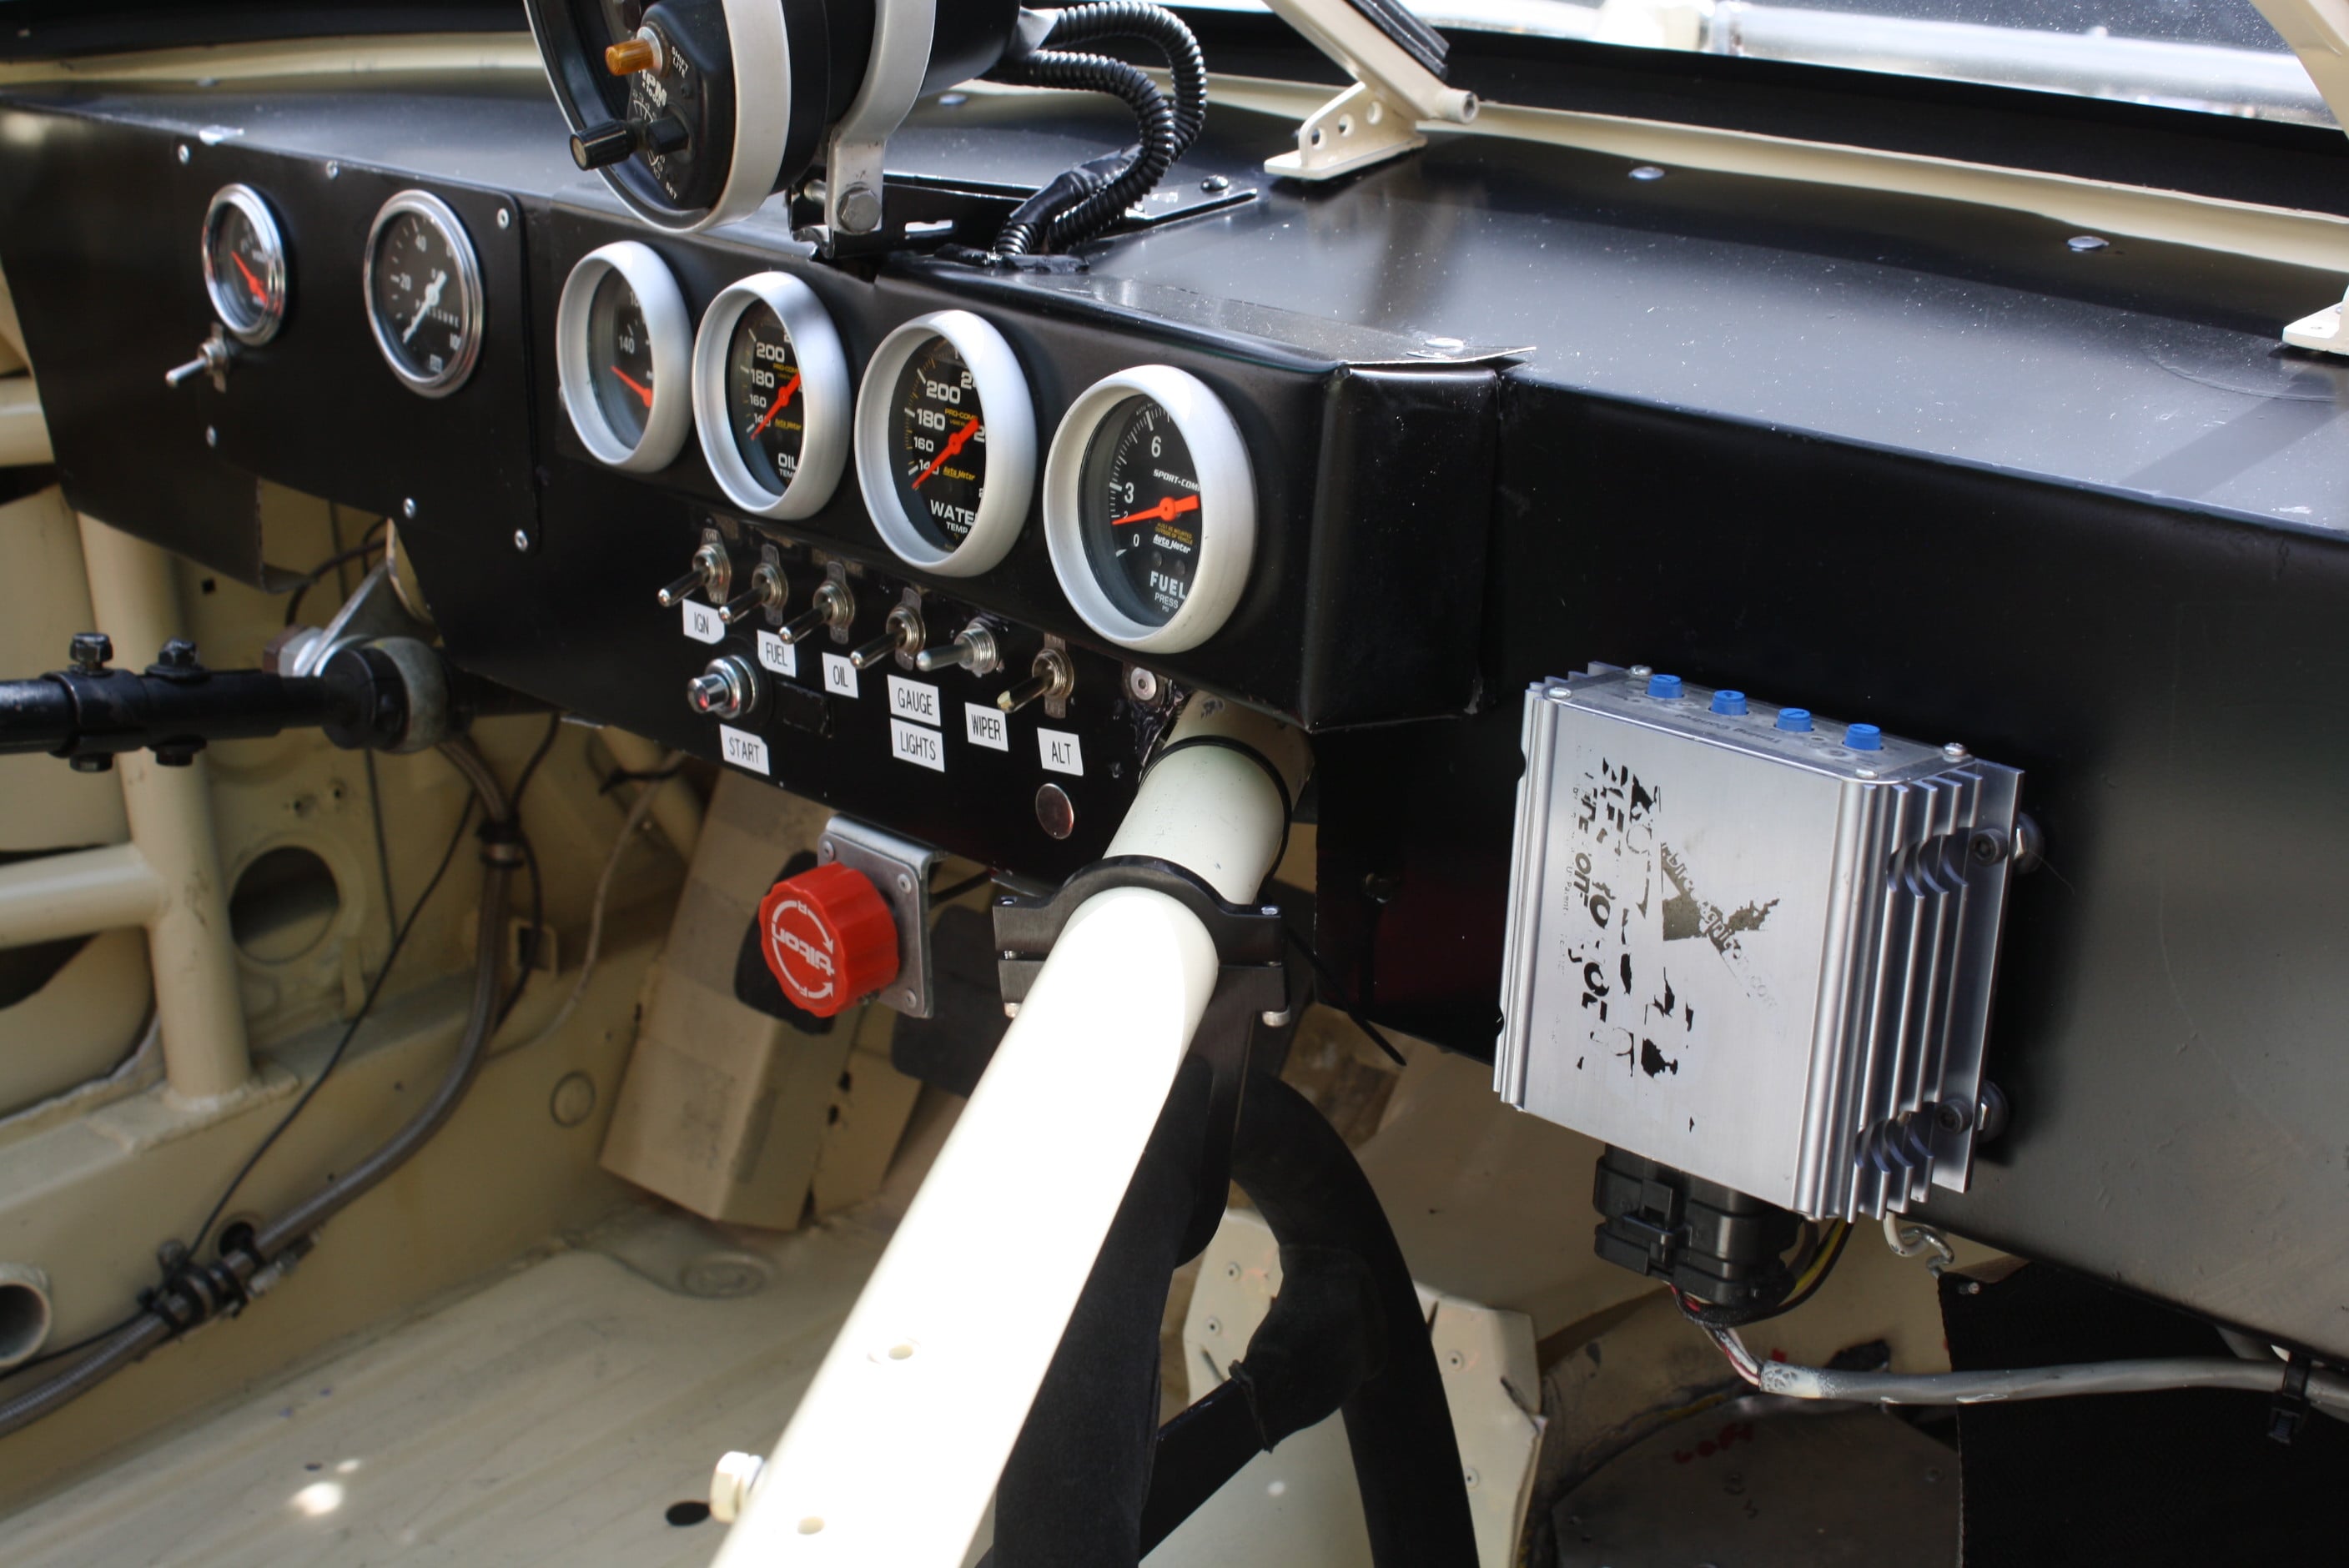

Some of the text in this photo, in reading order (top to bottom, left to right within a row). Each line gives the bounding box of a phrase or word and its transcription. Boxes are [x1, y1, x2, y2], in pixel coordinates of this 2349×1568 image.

[671, 46, 689, 70] SHIFT
[672, 58, 686, 78] LITE
[666, 182, 677, 199] SET
[400, 272, 412, 291] 20
[415, 299, 460, 329] PESSURE
[618, 335, 636, 354] 140
[757, 342, 785, 363] 200
[751, 368, 774, 389] 180
[750, 394, 767, 408] 160
[926, 380, 961, 405] 200
[917, 408, 946, 431] 180
[913, 436, 934, 453] 160
[1151, 435, 1162, 458] 6
[777, 453, 797, 470] OIL
[779, 468, 793, 479] TEM
[943, 466, 976, 481] Auto Meter
[1124, 482, 1134, 504] 3
[930, 499, 977, 526] WATE
[946, 521, 968, 535] TEMP
[1133, 533, 1140, 547] 0
[1153, 534, 1191, 554] Auto Meter
[1149, 570, 1186, 600] FUEL
[1154, 591, 1179, 609] PRESS
[693, 610, 710, 636] IGN
[765, 641, 788, 667] FUEL
[832, 665, 849, 688] OIL
[897, 687, 933, 716] GAUGE
[971, 713, 1002, 741] WIPER
[728, 738, 760, 764] START
[899, 731, 937, 761] LIGHTS
[1051, 740, 1071, 766] ALT
[772, 922, 835, 976] tilton
